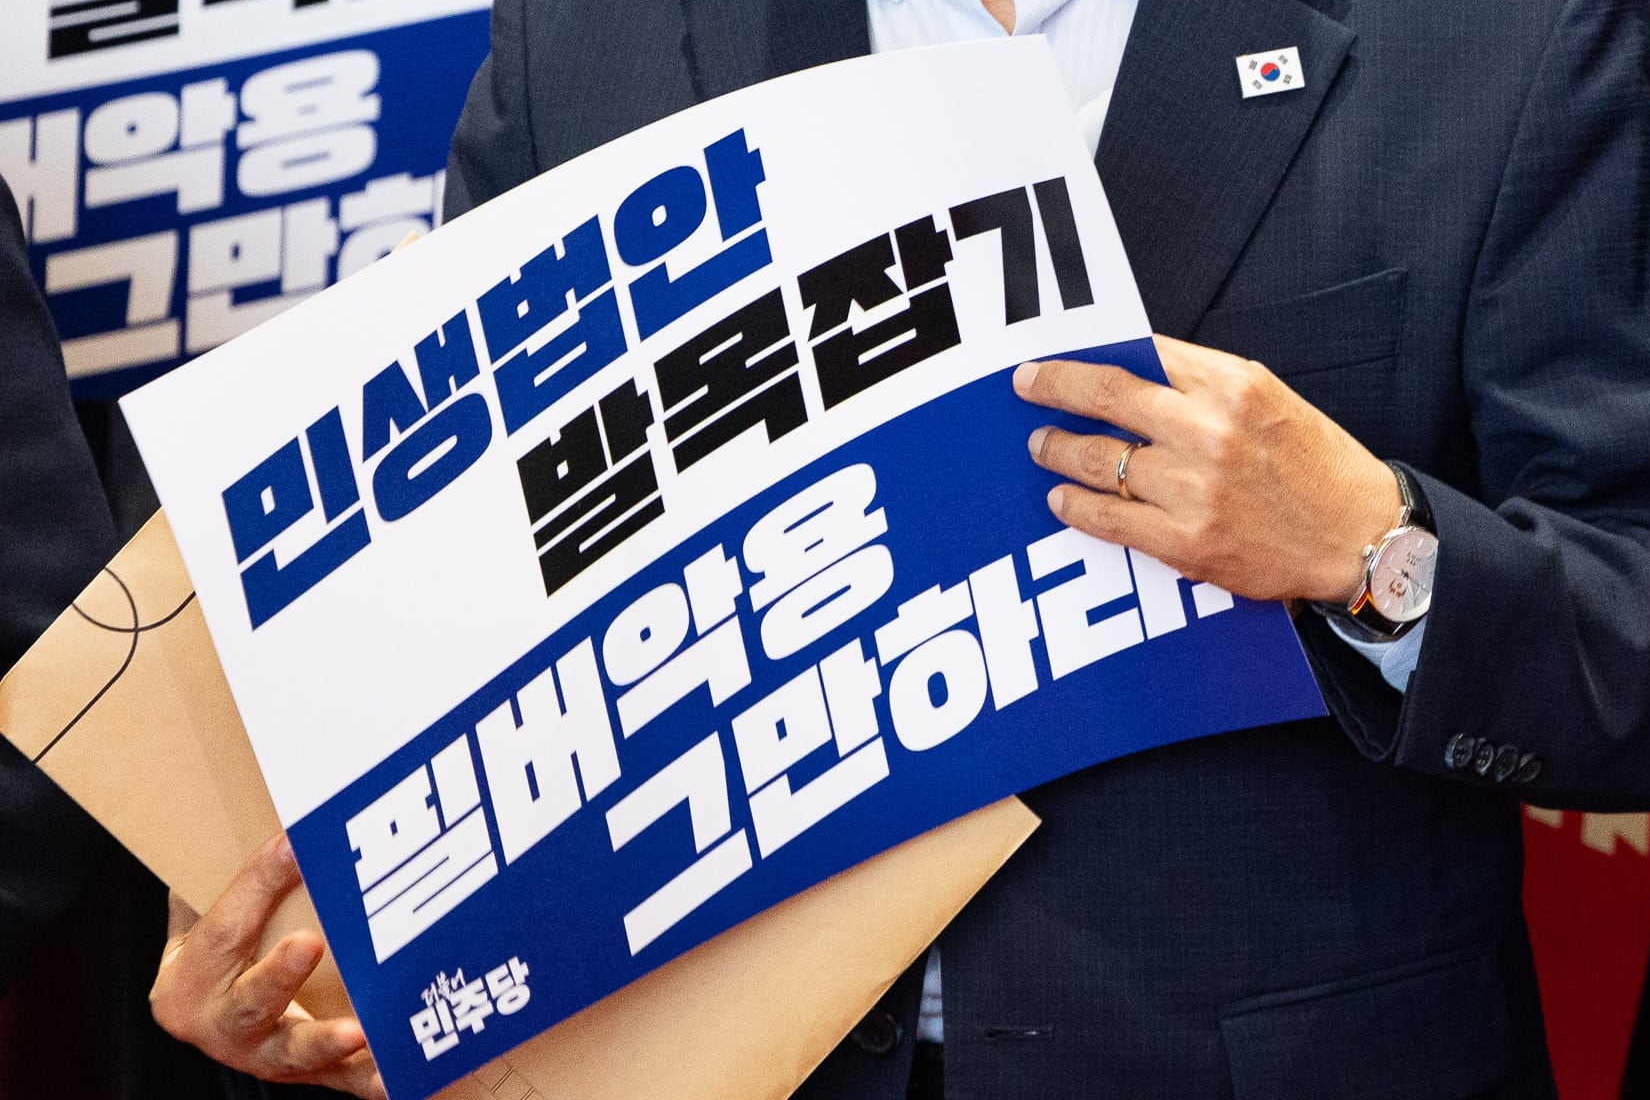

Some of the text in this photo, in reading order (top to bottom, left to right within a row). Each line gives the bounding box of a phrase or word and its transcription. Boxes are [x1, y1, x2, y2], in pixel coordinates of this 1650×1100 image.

[222, 127, 773, 632] 민생법안
[515, 175, 1096, 598] 발목잡기
[345, 462, 894, 964] 필버악용
[606, 526, 1235, 956] 그만하라
[409, 955, 530, 1062] 민주당
